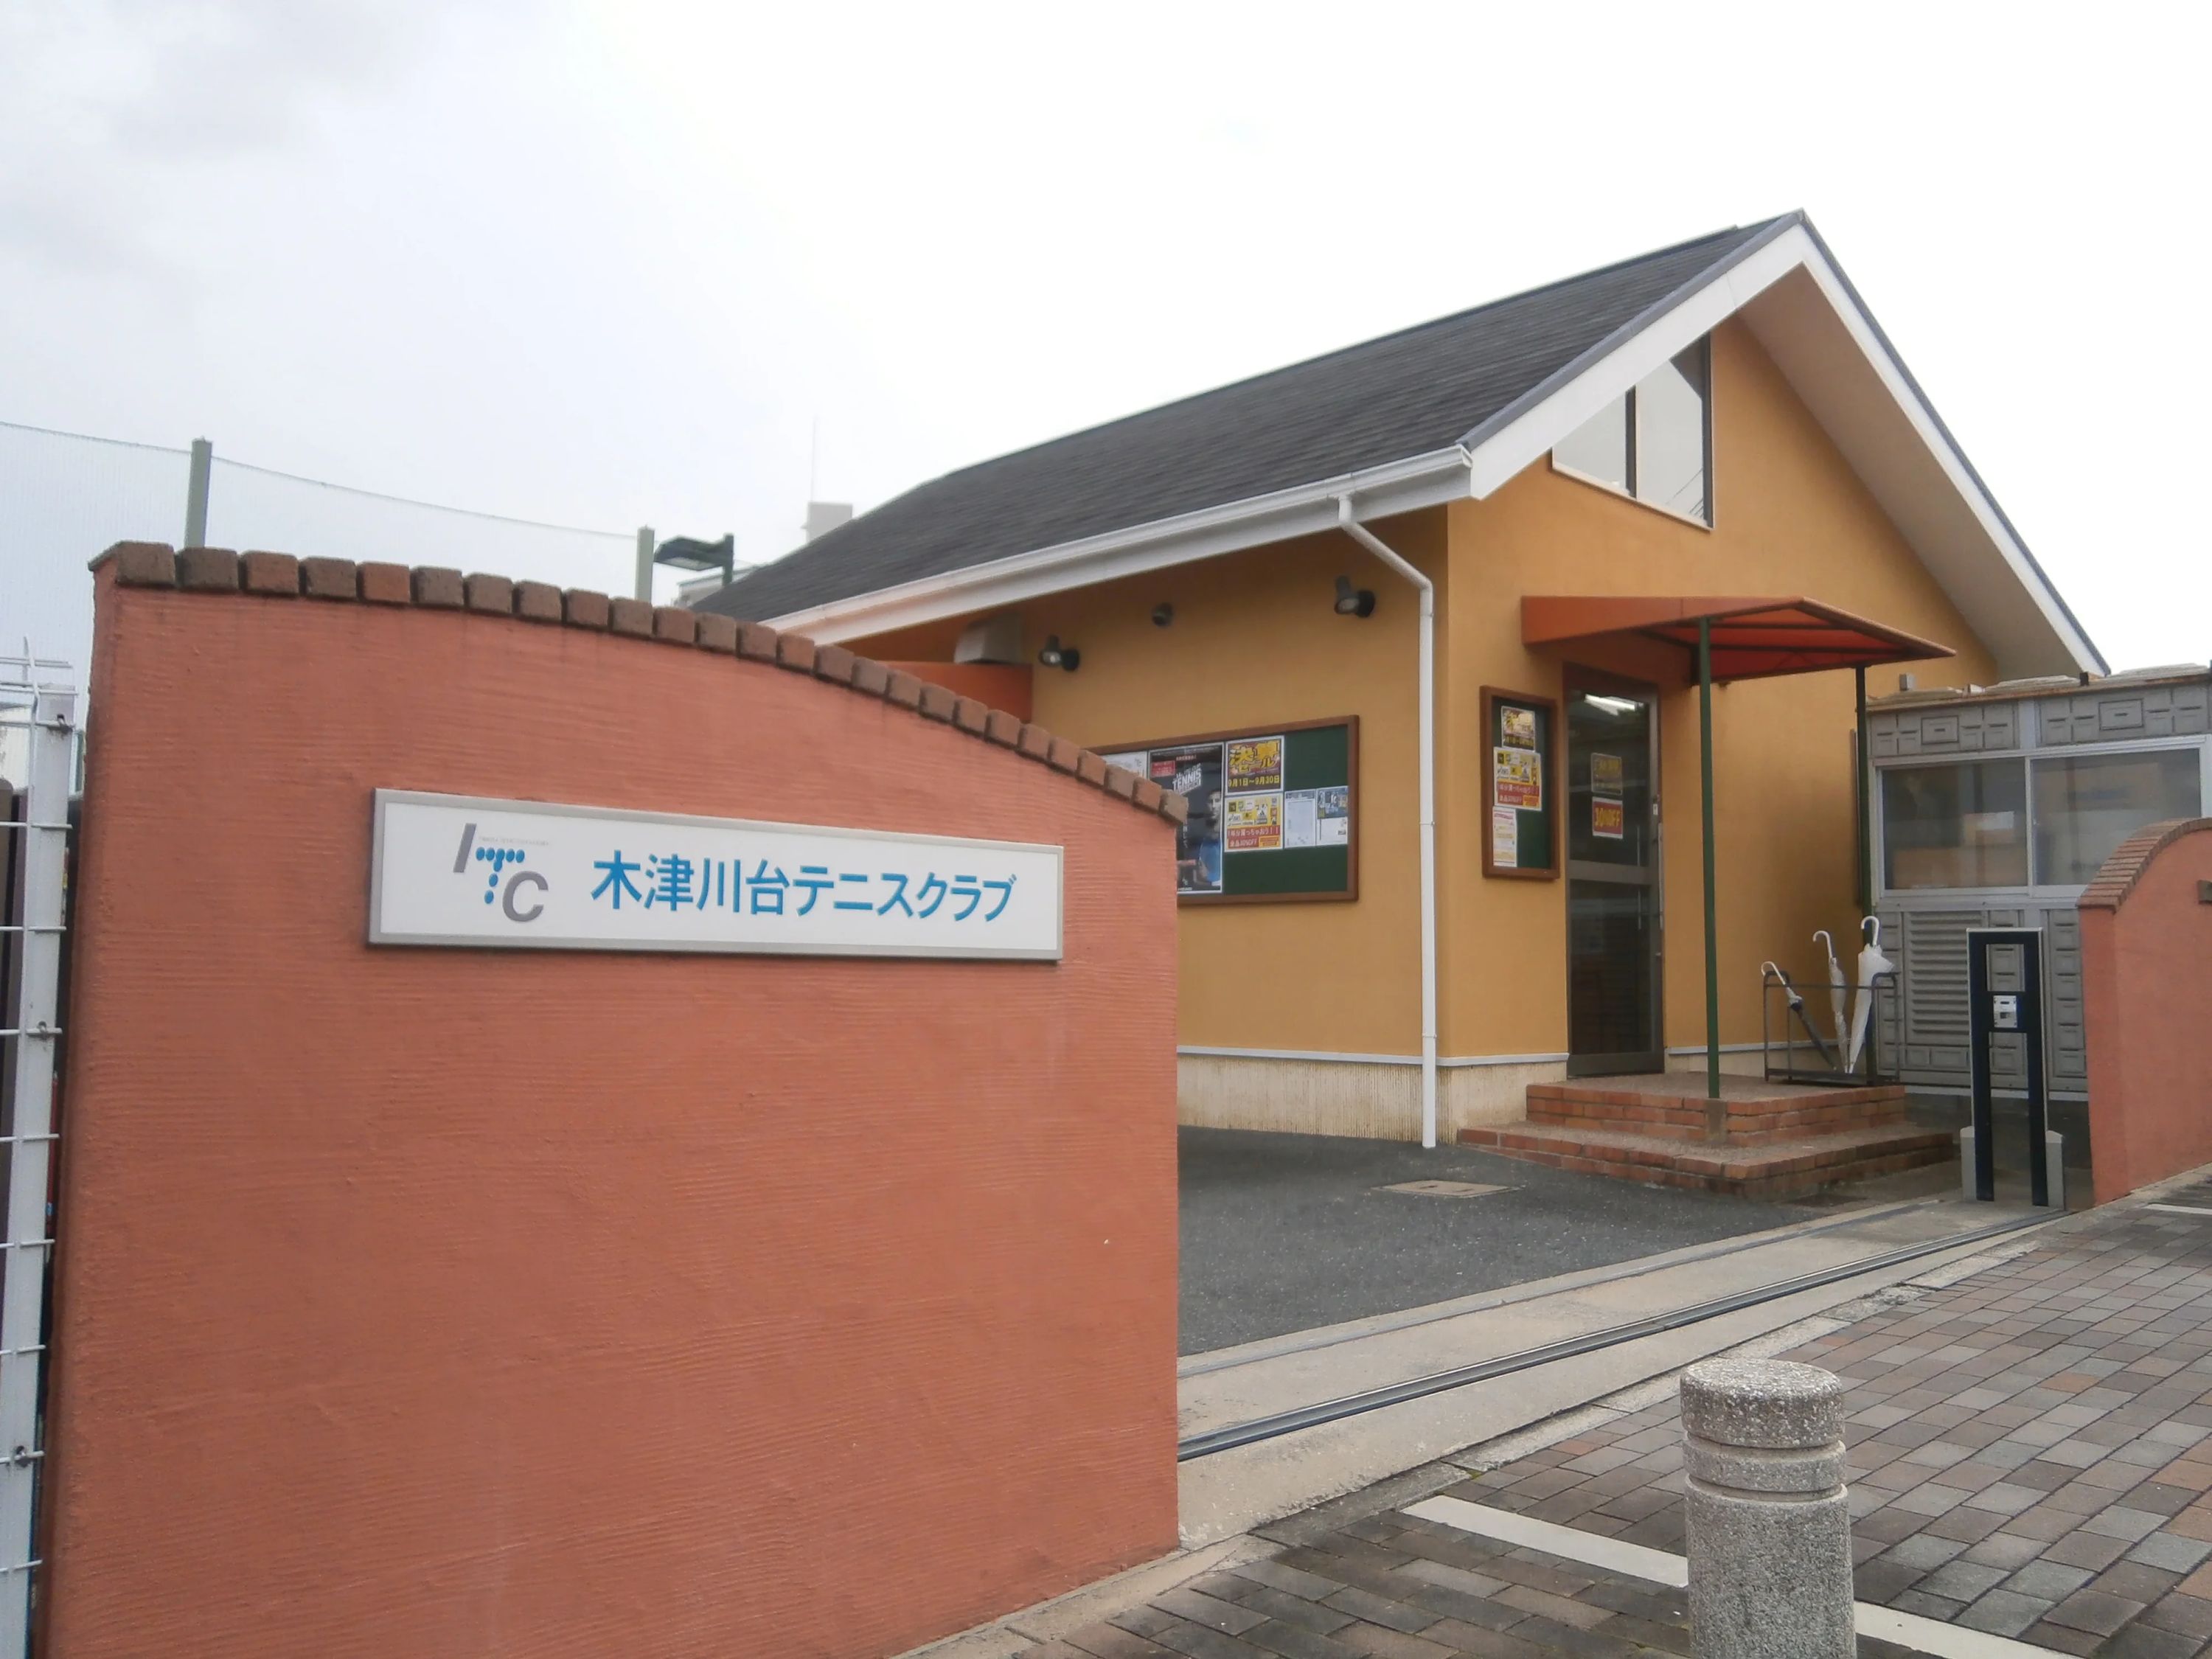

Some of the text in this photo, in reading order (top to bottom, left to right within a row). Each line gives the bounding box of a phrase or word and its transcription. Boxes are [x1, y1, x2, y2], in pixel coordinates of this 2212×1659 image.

[1172, 768, 1201, 794] TENNIS
[591, 850, 1017, 922] 木津川台テニスクラブ
